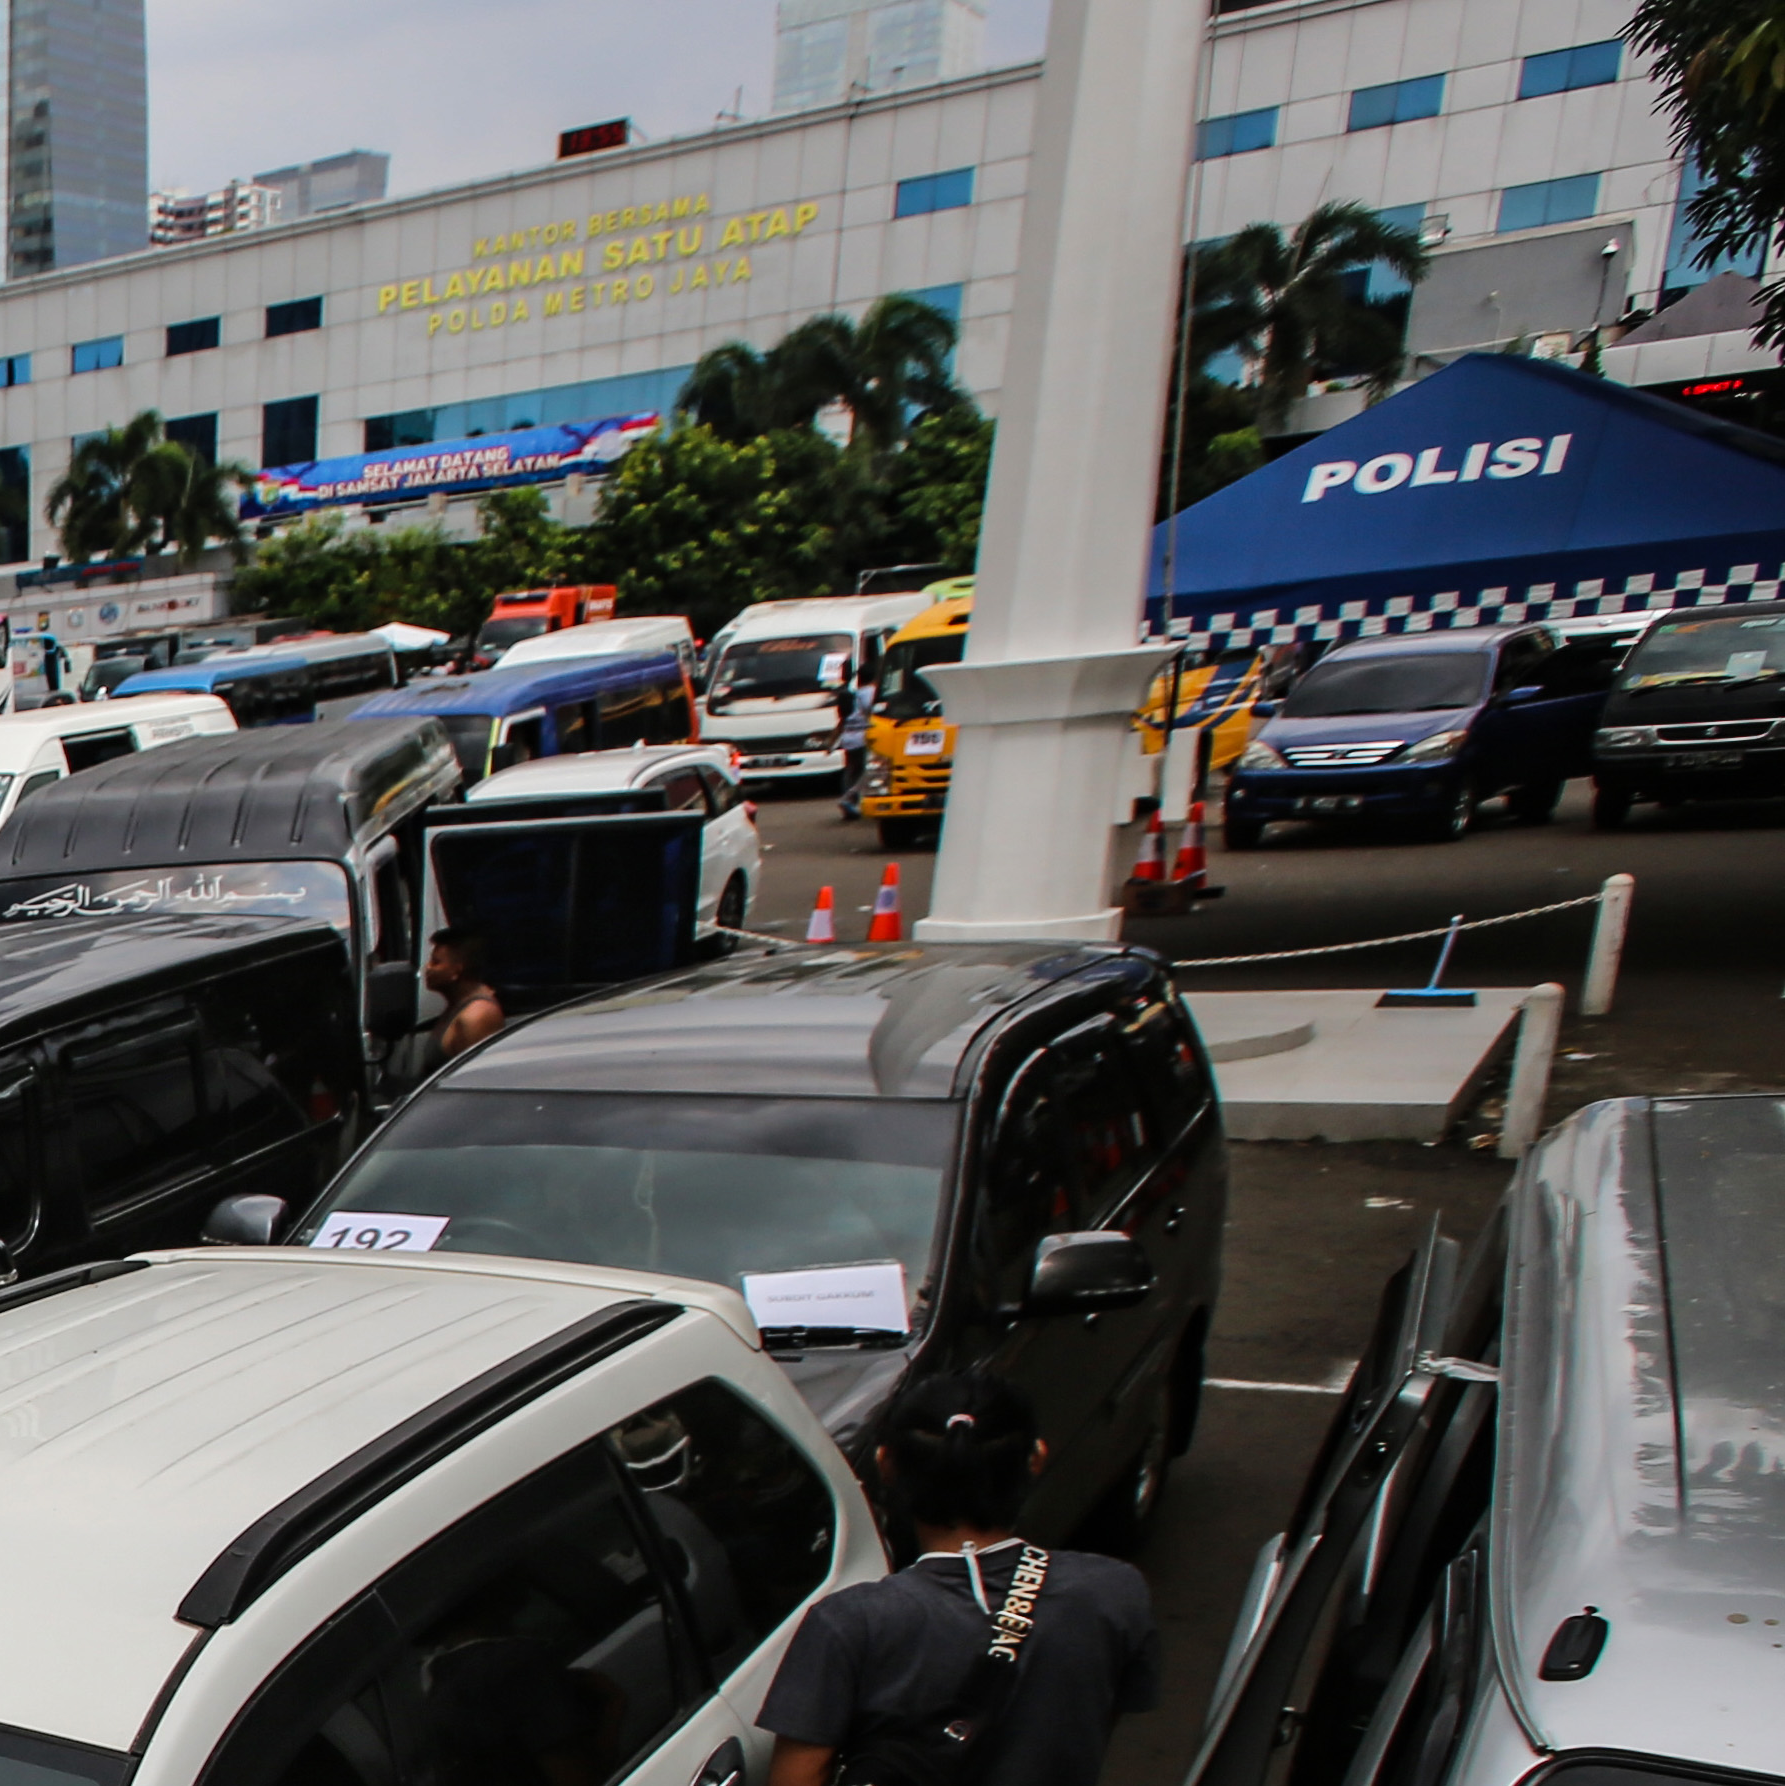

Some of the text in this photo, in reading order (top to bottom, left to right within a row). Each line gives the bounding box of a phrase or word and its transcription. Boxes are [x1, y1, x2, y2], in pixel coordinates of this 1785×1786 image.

[377, 201, 819, 314] PELAYANAN SATU ATAP
[473, 193, 710, 258] KANTOR BERSAMA
[429, 256, 753, 338] POLDA METRO JAYA
[318, 453, 562, 499] DI SAMSAT JAKARTA SELATAN
[363, 446, 510, 480] SELAMAT DATANG
[1301, 432, 1572, 504] POLISI
[331, 1226, 412, 1249] 192
